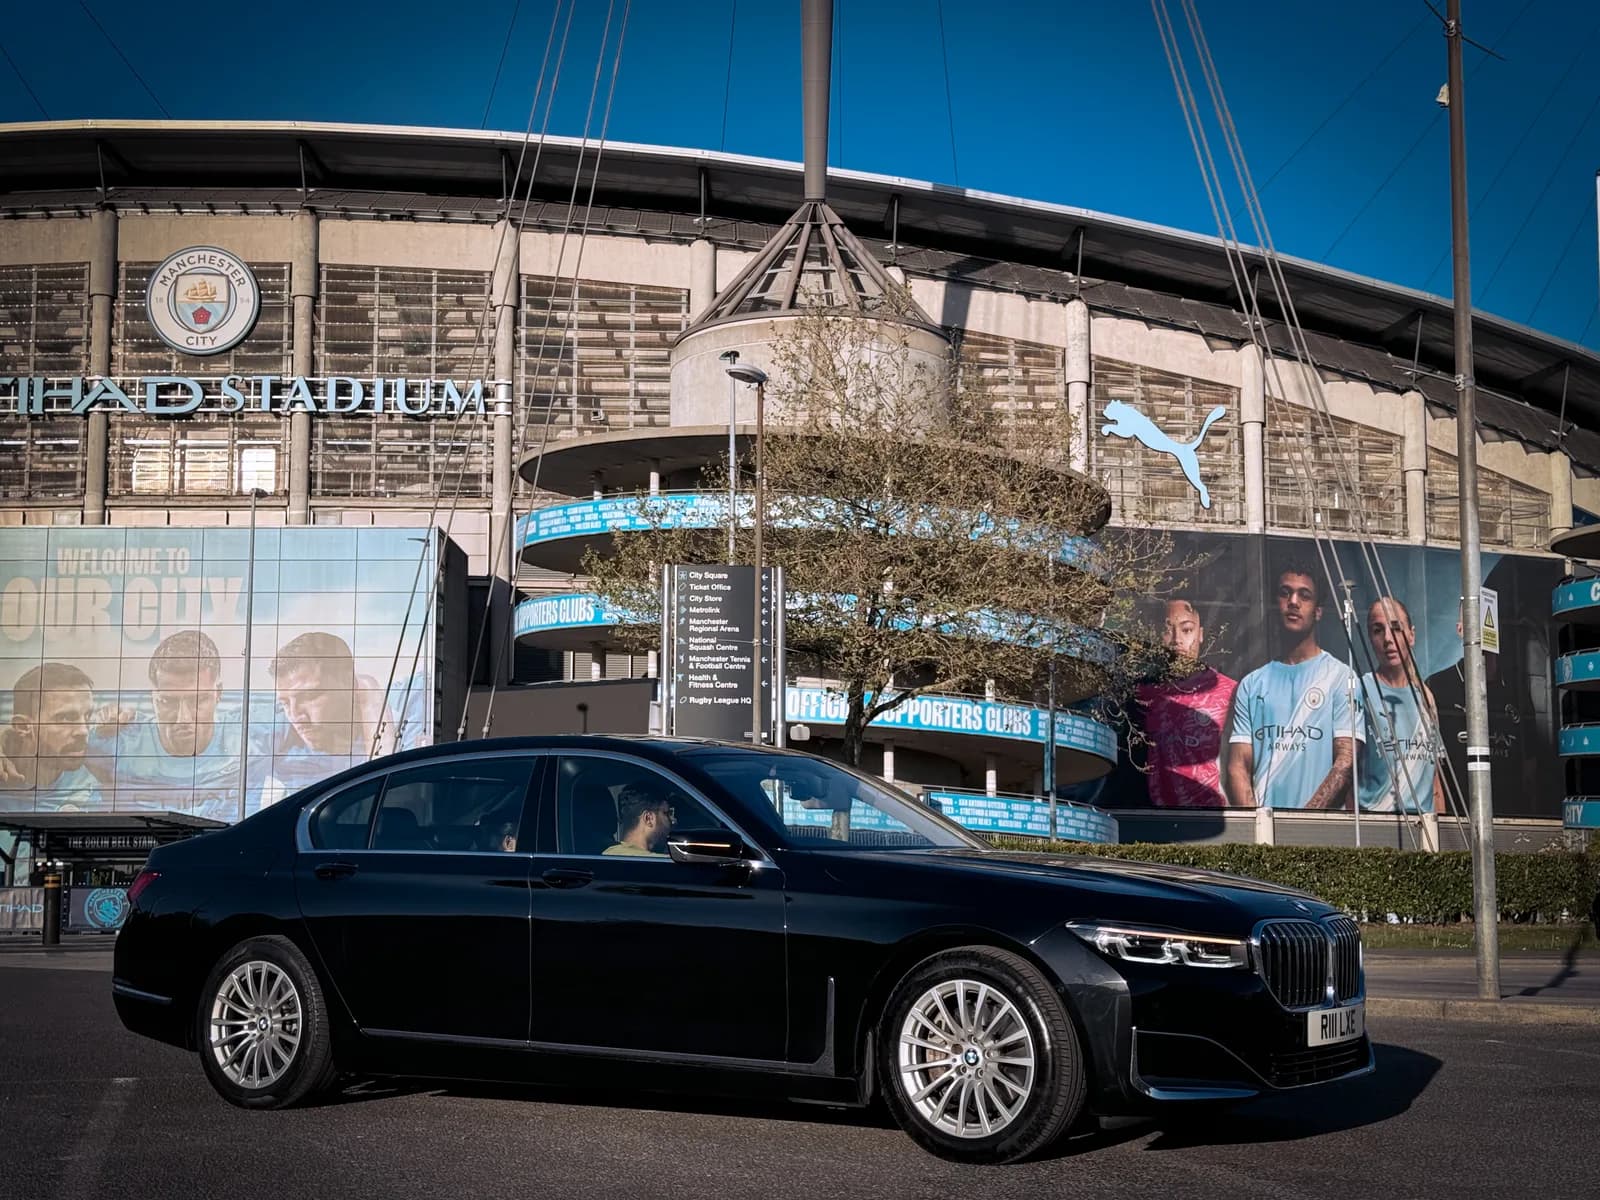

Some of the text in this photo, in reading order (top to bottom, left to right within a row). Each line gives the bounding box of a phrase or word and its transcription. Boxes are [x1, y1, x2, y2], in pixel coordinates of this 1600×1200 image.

[159, 254, 246, 287] MANCHESTER
[186, 335, 218, 346] CITY
[220, 374, 487, 416] STADIUM
[57, 547, 191, 576] WELCOME TO
[689, 571, 729, 581] City Square
[689, 583, 732, 591] Ticket Office
[689, 595, 703, 604] City
[2, 576, 244, 642] OUR CITY
[559, 597, 595, 624] CLUBS
[689, 606, 721, 614] Metrolink
[689, 625, 740, 634] Regional Arena
[688, 636, 717, 644] National
[688, 643, 739, 652] Squash Centre
[688, 655, 752, 664] Manchester Tennis
[688, 662, 747, 671] & Football Centre
[712, 673, 718, 681] &
[688, 681, 739, 689] Fitness Centre
[689, 696, 752, 705] Rugby League HQ
[788, 690, 850, 720] OFFICI
[985, 705, 1032, 736] CLUBS
[1255, 724, 1324, 741] ETIHAD
[68, 836, 83, 848] THE
[112, 836, 132, 848] BELL
[1340, 1009, 1355, 1036] LXE
